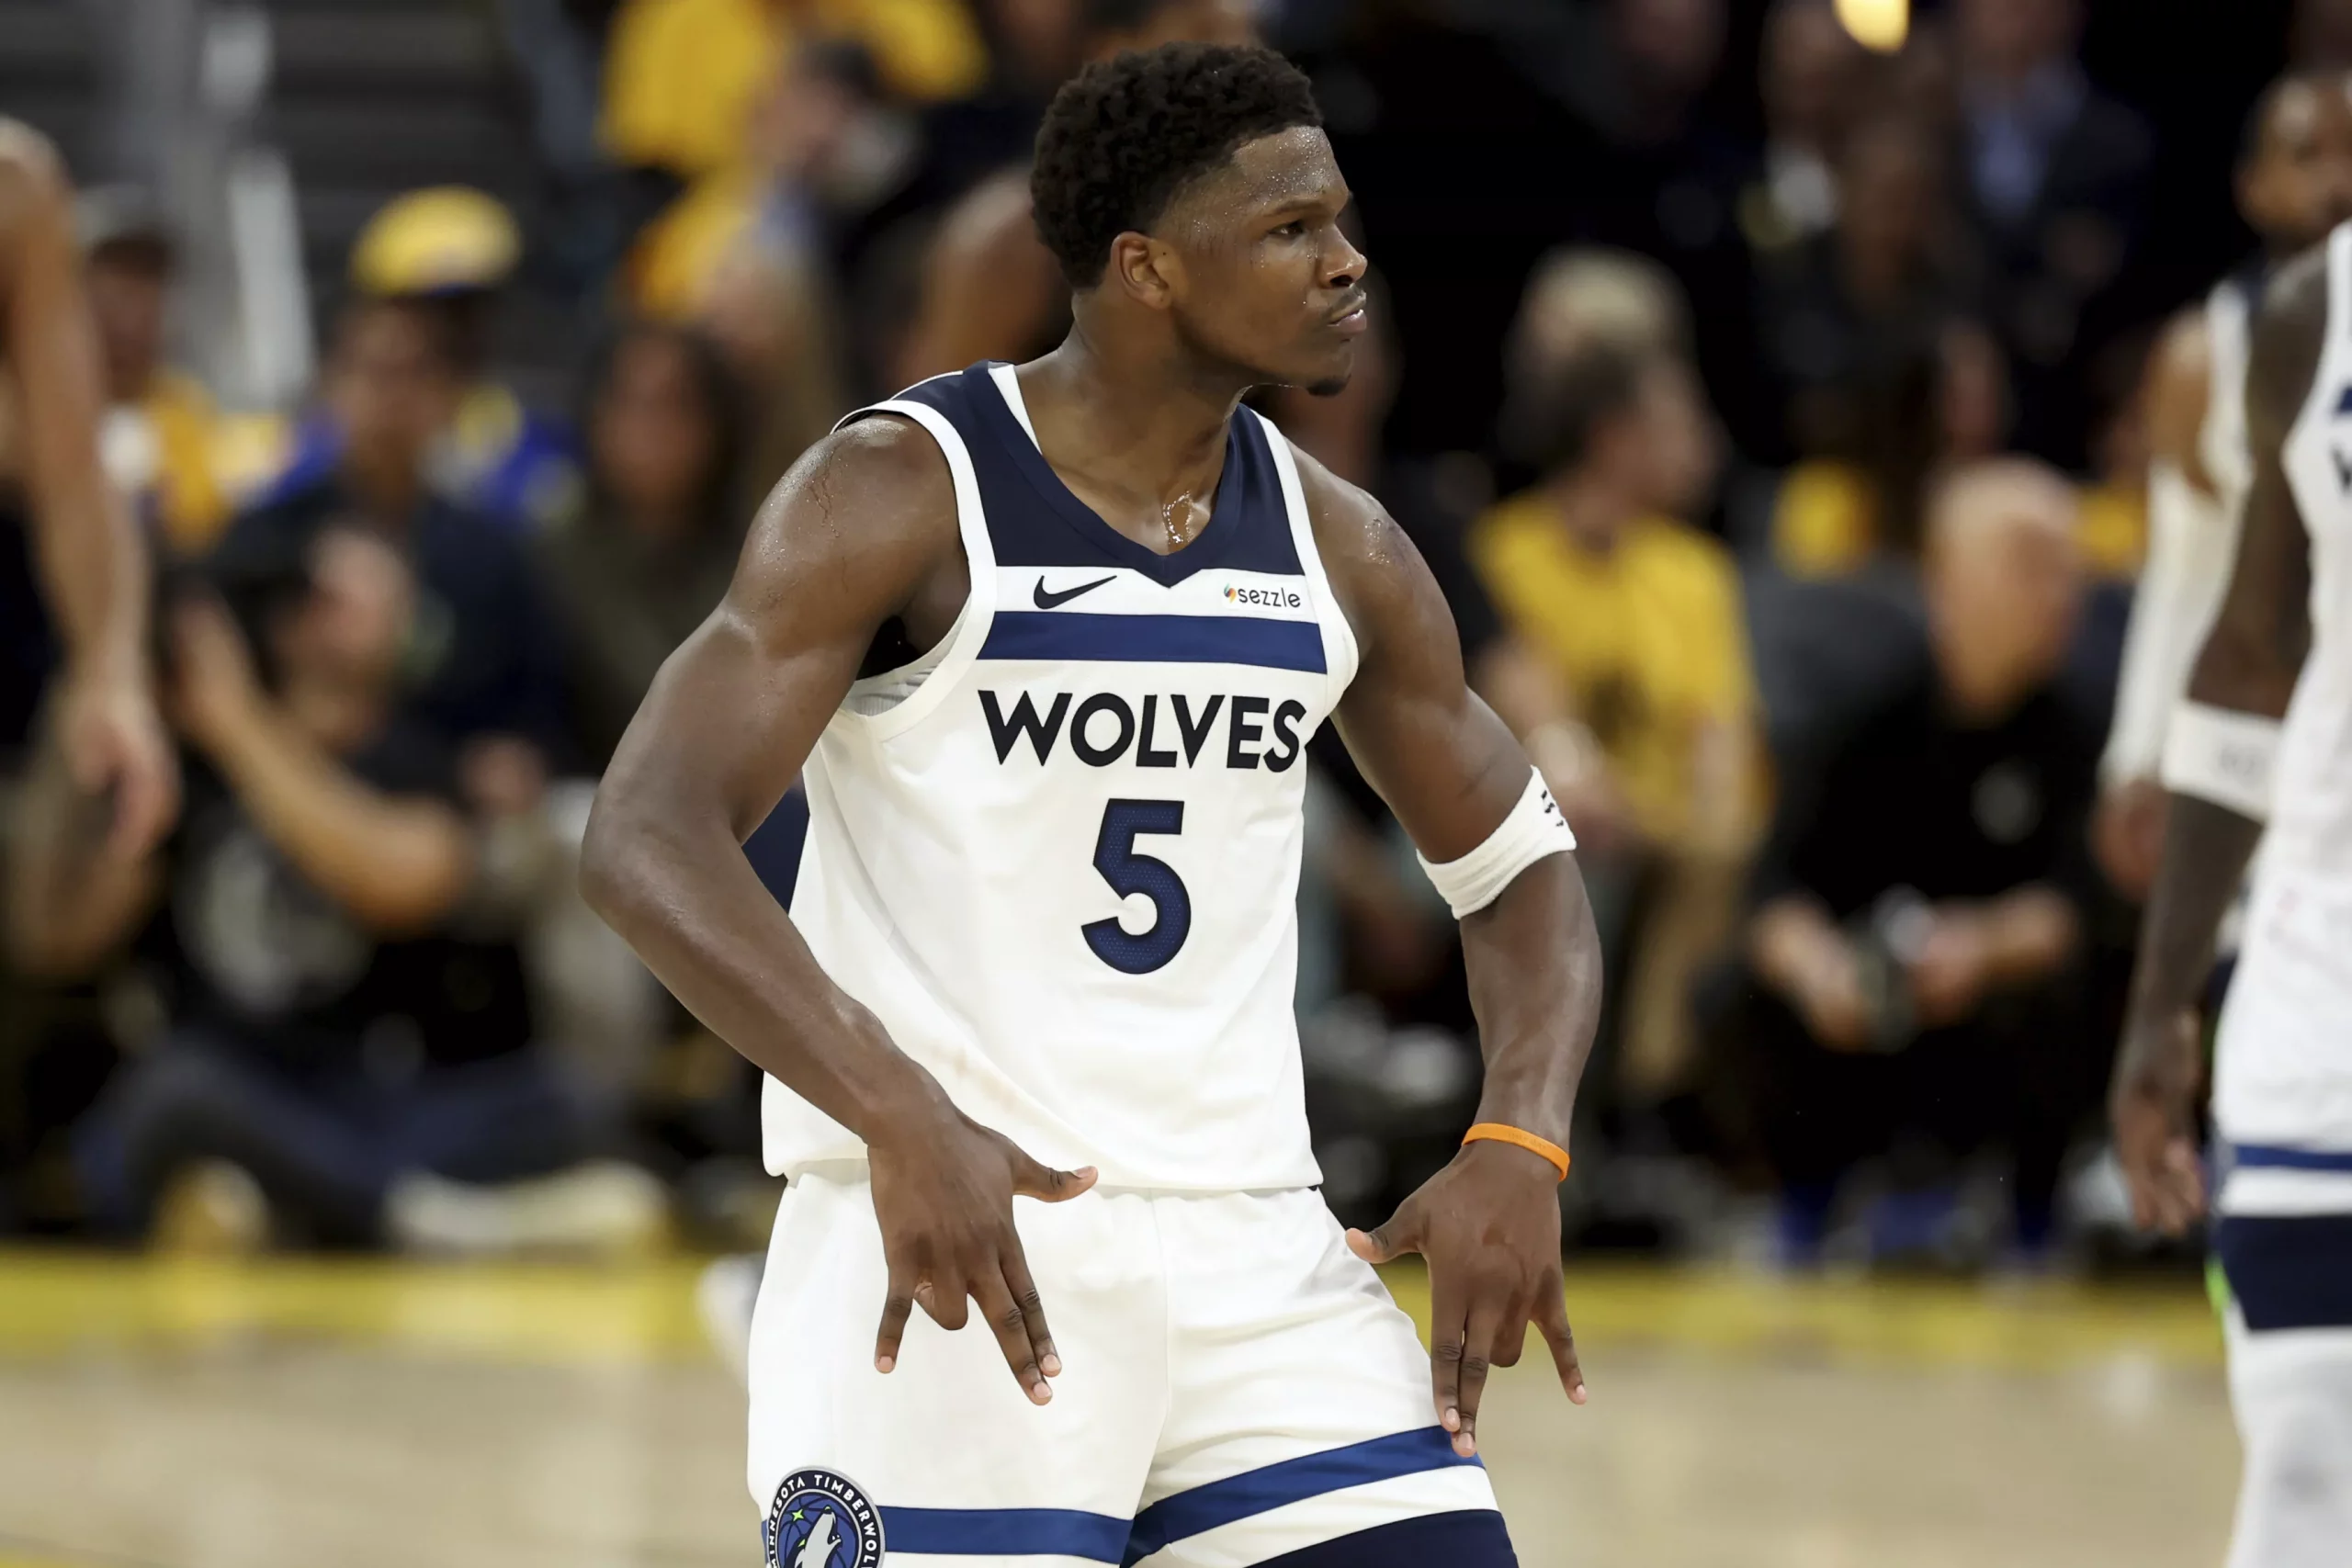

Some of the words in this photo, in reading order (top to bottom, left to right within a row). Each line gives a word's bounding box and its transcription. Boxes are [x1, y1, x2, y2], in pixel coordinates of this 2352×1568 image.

[1238, 587, 1301, 608] sezzle
[978, 690, 1306, 773] WOLVES
[1080, 798, 1192, 975] 5
[814, 1474, 877, 1568] TIMBERWOL
